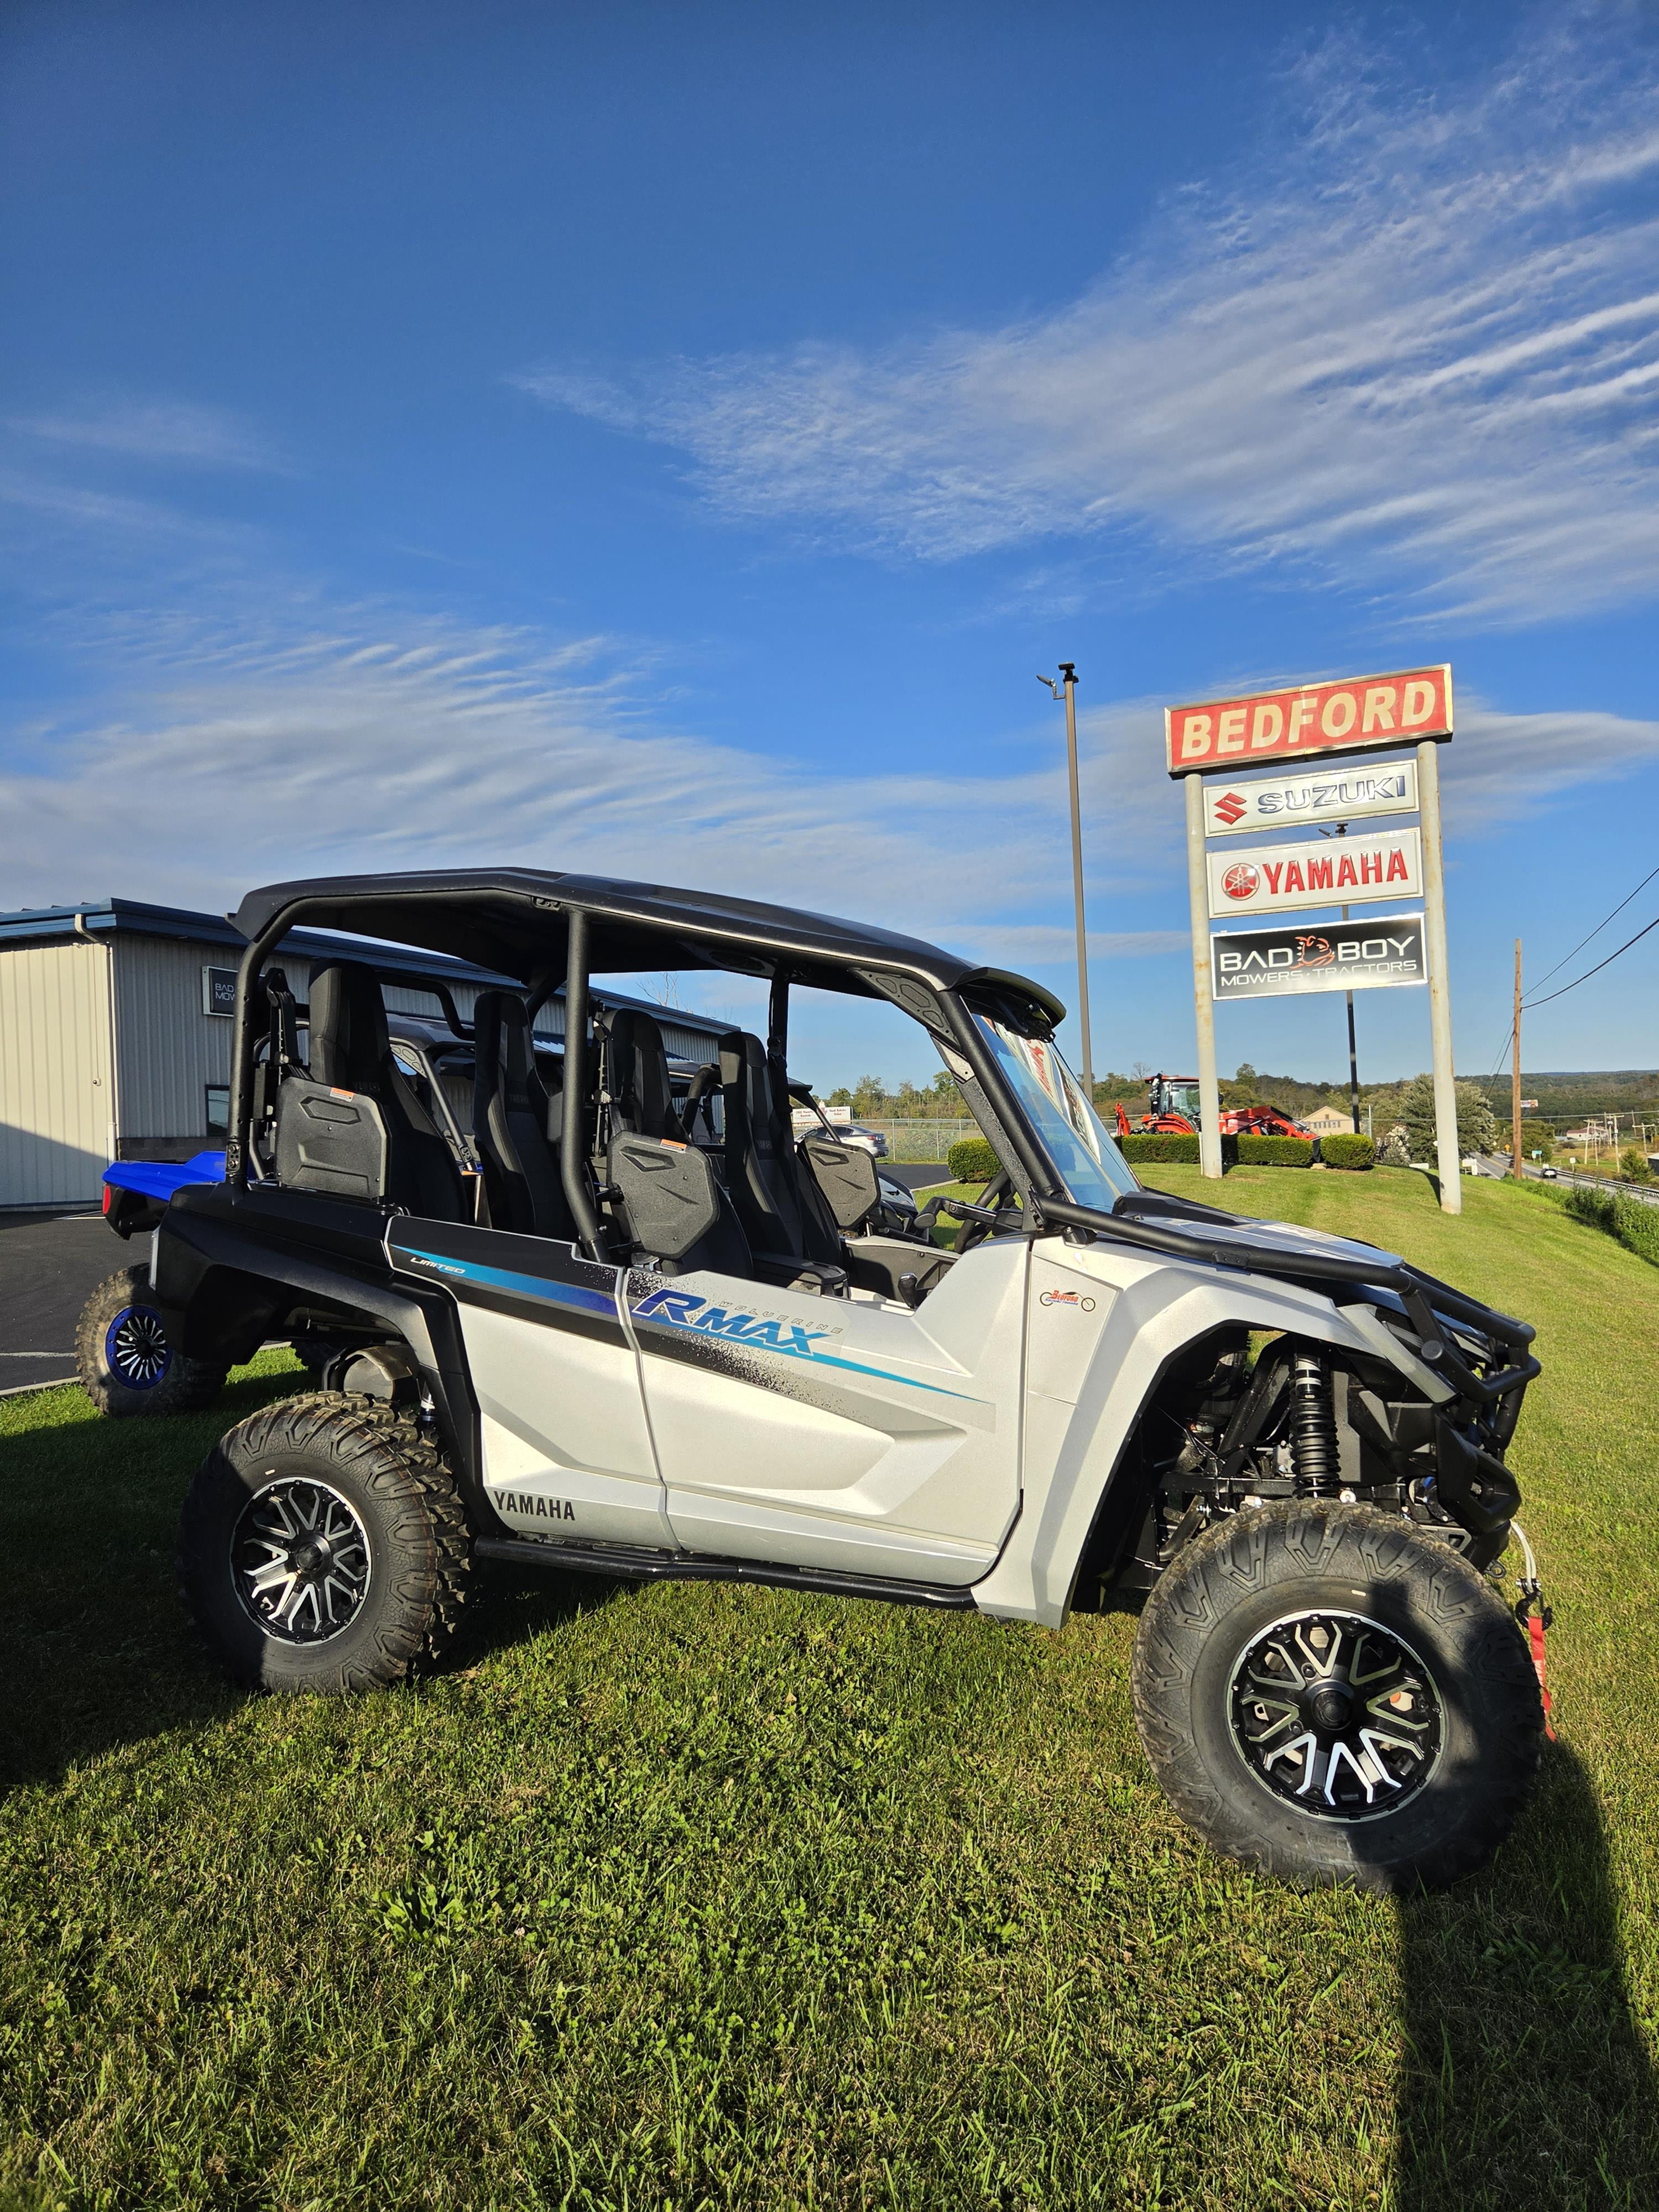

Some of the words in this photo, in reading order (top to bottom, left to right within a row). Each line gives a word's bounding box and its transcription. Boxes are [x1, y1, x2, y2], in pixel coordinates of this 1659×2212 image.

[1181, 680, 1436, 759] BEDFORD
[1258, 775, 1406, 814] SUZUKI
[1262, 846, 1408, 895] YAMAHA
[1220, 947, 1293, 972] BAD
[1337, 936, 1416, 962] BOY
[215, 983, 234, 993] BAD
[1221, 970, 1303, 987] MOWERS
[1311, 959, 1417, 979] TRACTORS
[410, 1257, 466, 1274] LIMITED
[1051, 1290, 1079, 1302] BEDFORD
[632, 1288, 833, 1357] RMAX
[718, 1300, 843, 1334] WOLVERINE
[493, 1490, 576, 1521] YAMAHA
